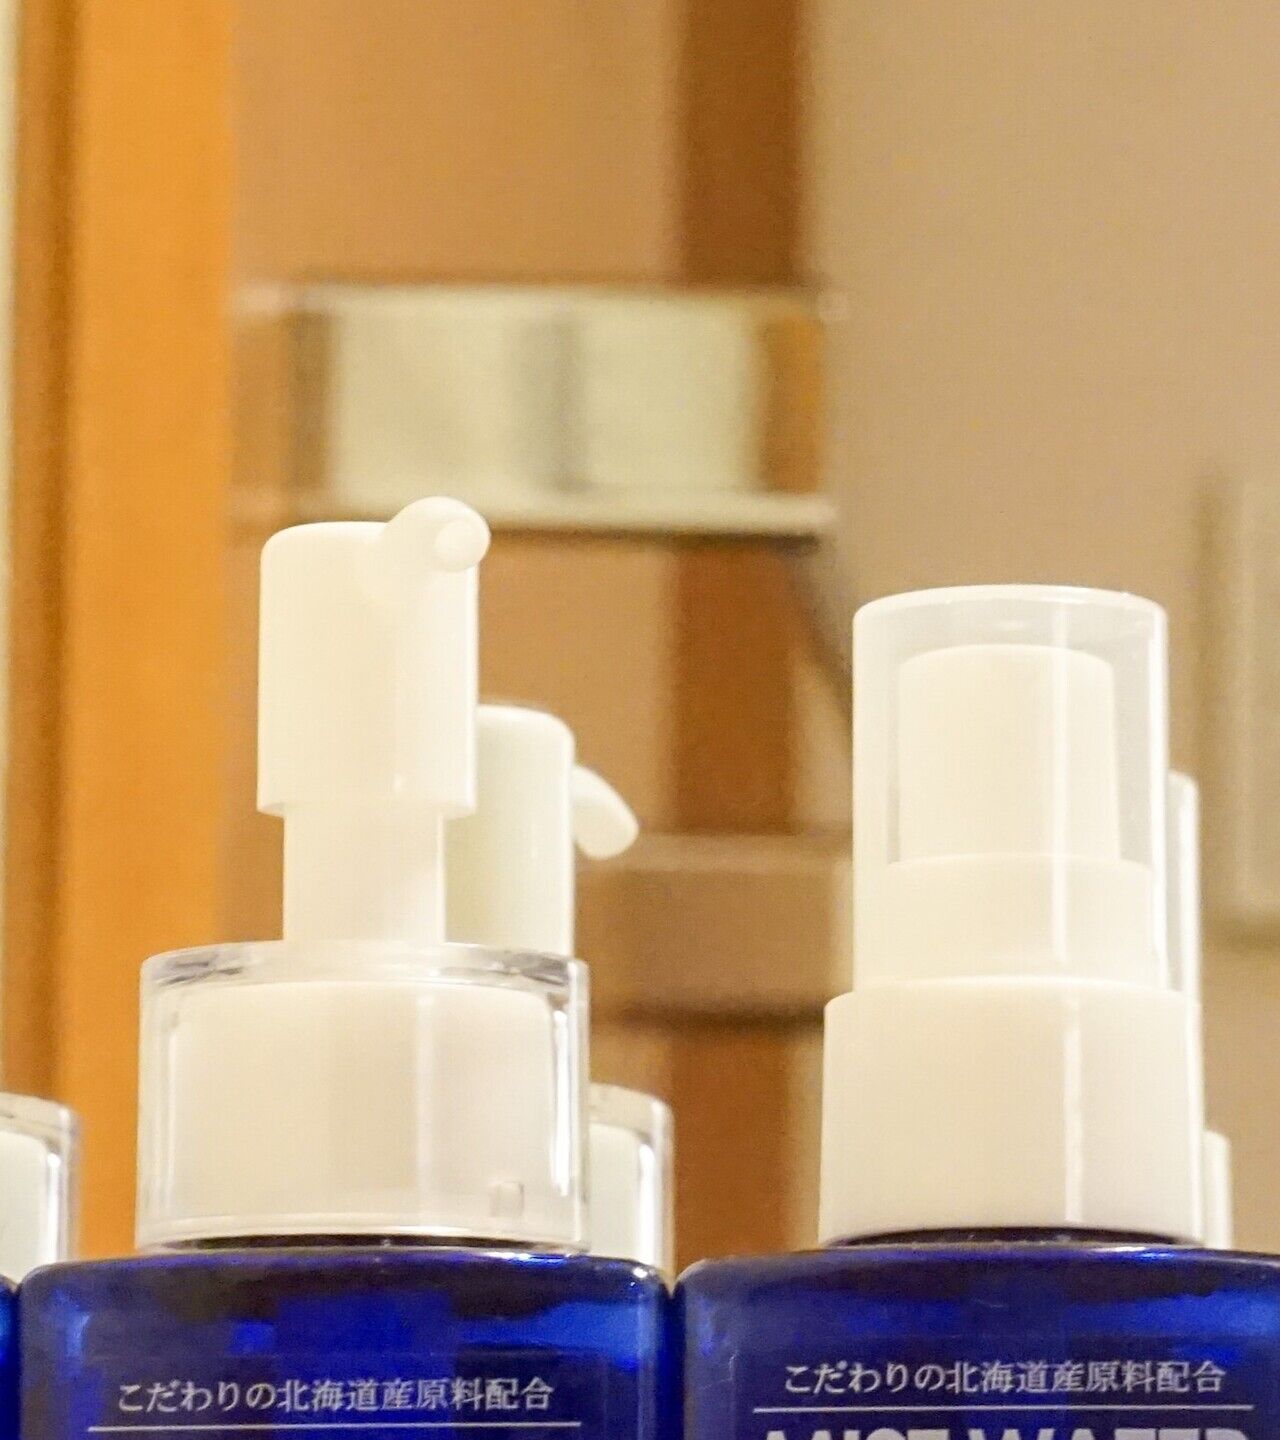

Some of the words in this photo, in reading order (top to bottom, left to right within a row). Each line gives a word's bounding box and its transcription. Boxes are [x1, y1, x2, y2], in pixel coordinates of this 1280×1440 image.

[117, 1376, 554, 1414] こだわりの北海道産原料配合
[785, 1359, 1226, 1395] こだわりの北海道産原料配合
